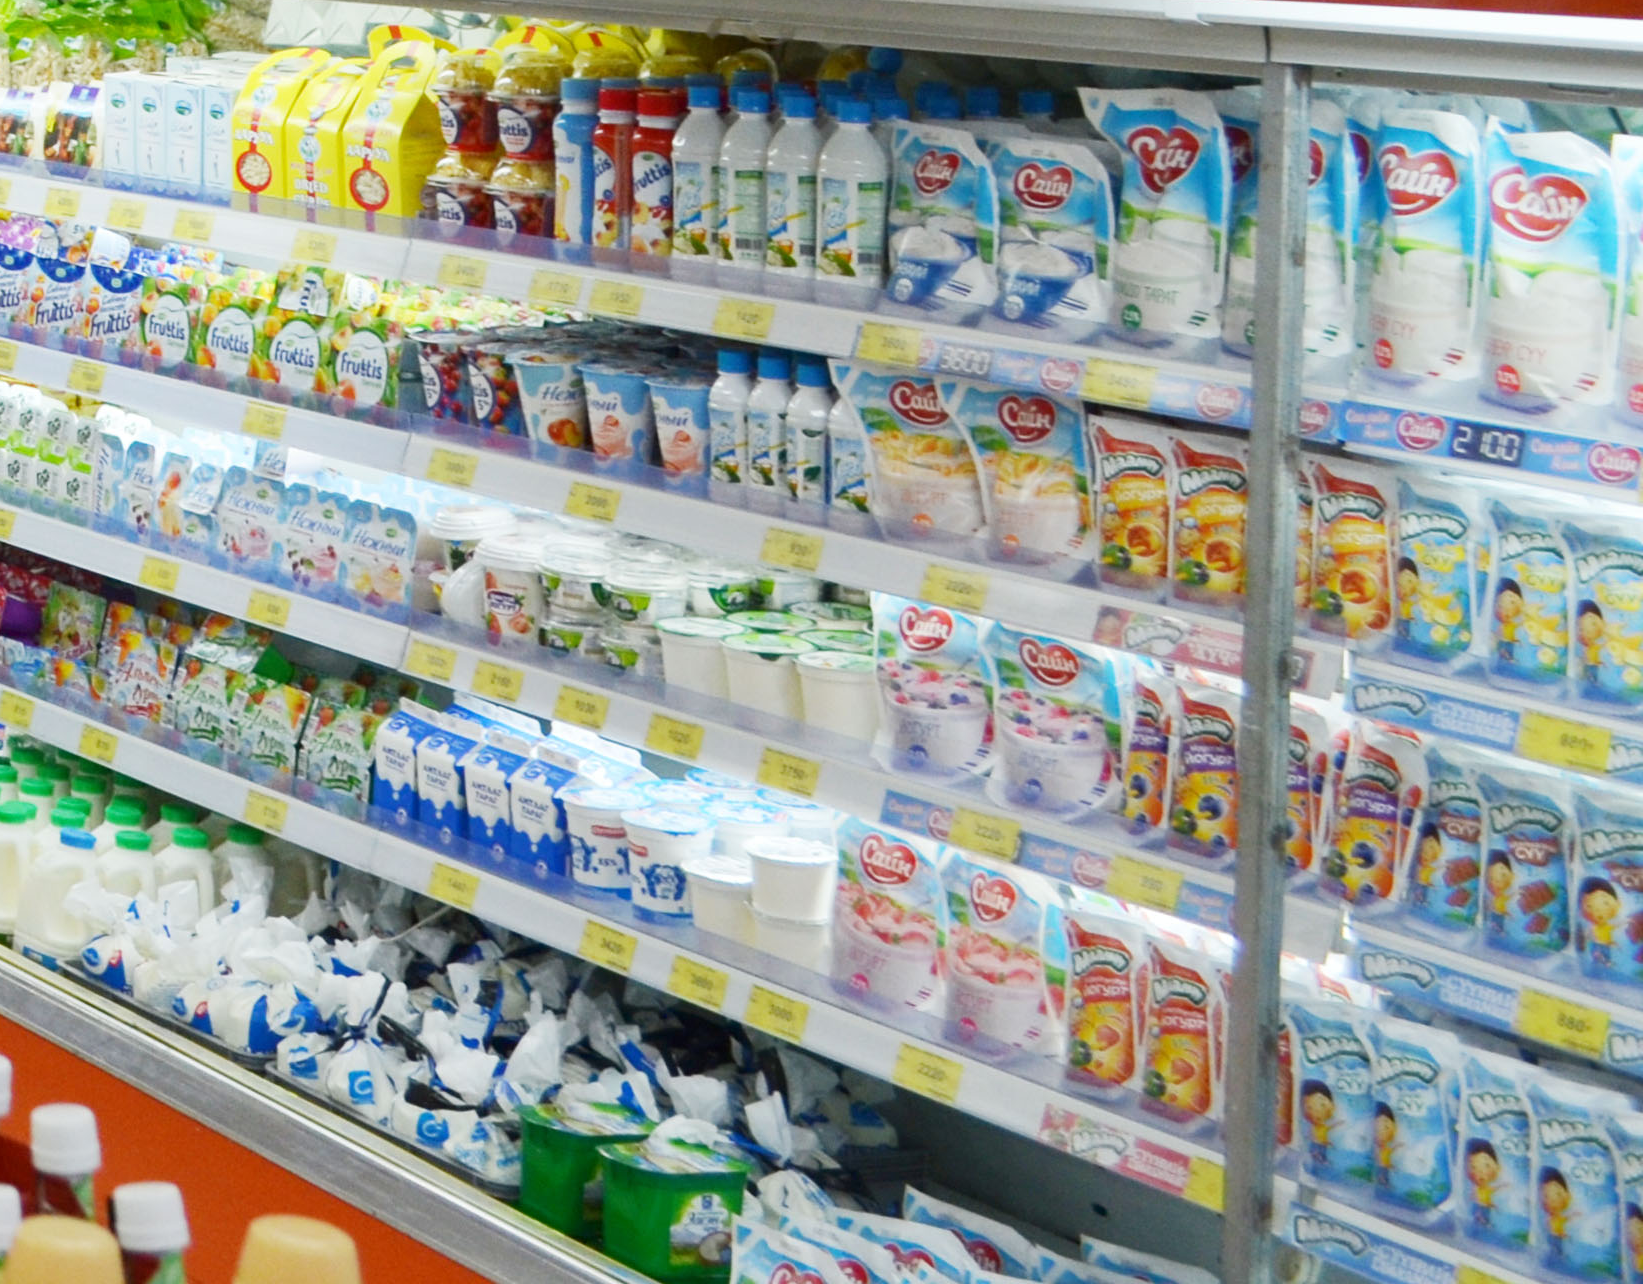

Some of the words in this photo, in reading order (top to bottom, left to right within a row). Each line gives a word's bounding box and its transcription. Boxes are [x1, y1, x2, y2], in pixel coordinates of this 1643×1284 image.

[89, 314, 132, 340] fruttis
[149, 316, 186, 341] fruttis
[211, 325, 250, 356] fruttis
[274, 340, 314, 371] fruttis
[340, 349, 383, 383] fruttis
